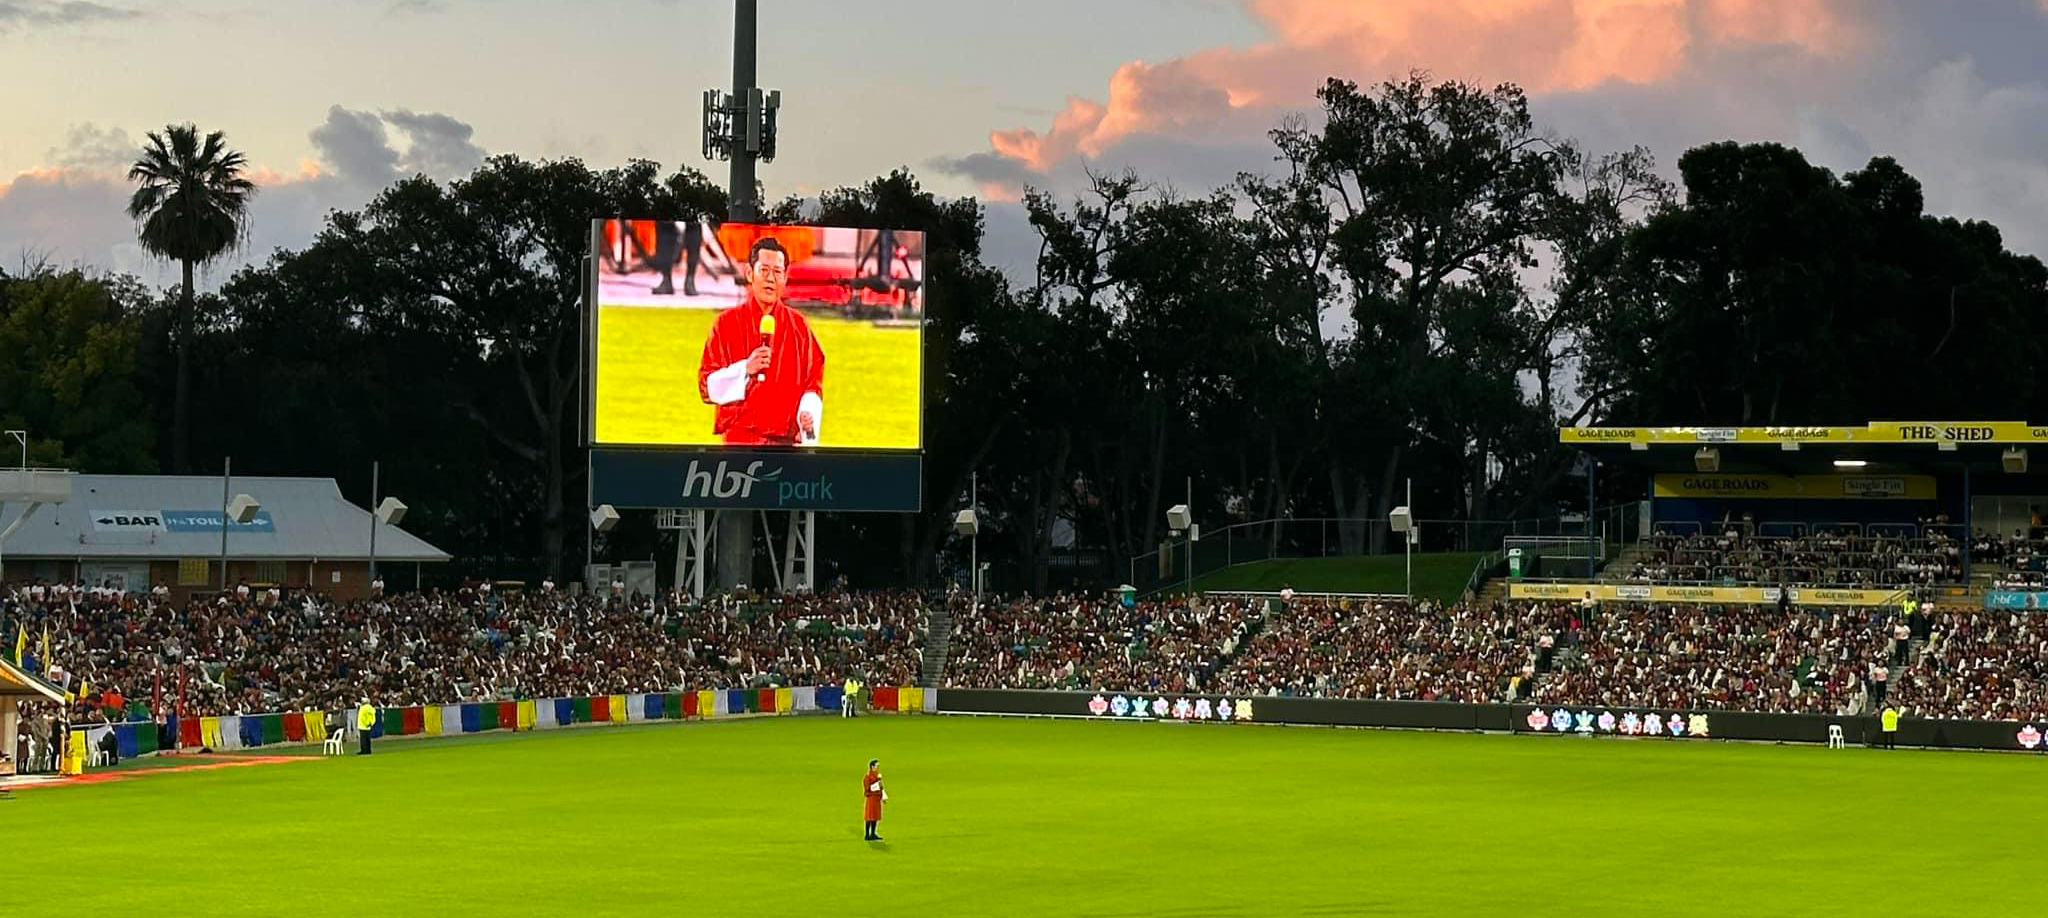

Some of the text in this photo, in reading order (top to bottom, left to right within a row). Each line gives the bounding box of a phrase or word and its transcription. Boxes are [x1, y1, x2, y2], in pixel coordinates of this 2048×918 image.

[1578, 429, 1636, 438] GAGE ROADS
[1899, 426, 1994, 440] THE SHED
[2032, 429, 2048, 438] GA
[682, 460, 833, 506] hbf park
[1683, 478, 1769, 490] GAGE ROADS
[115, 516, 160, 526] BAR
